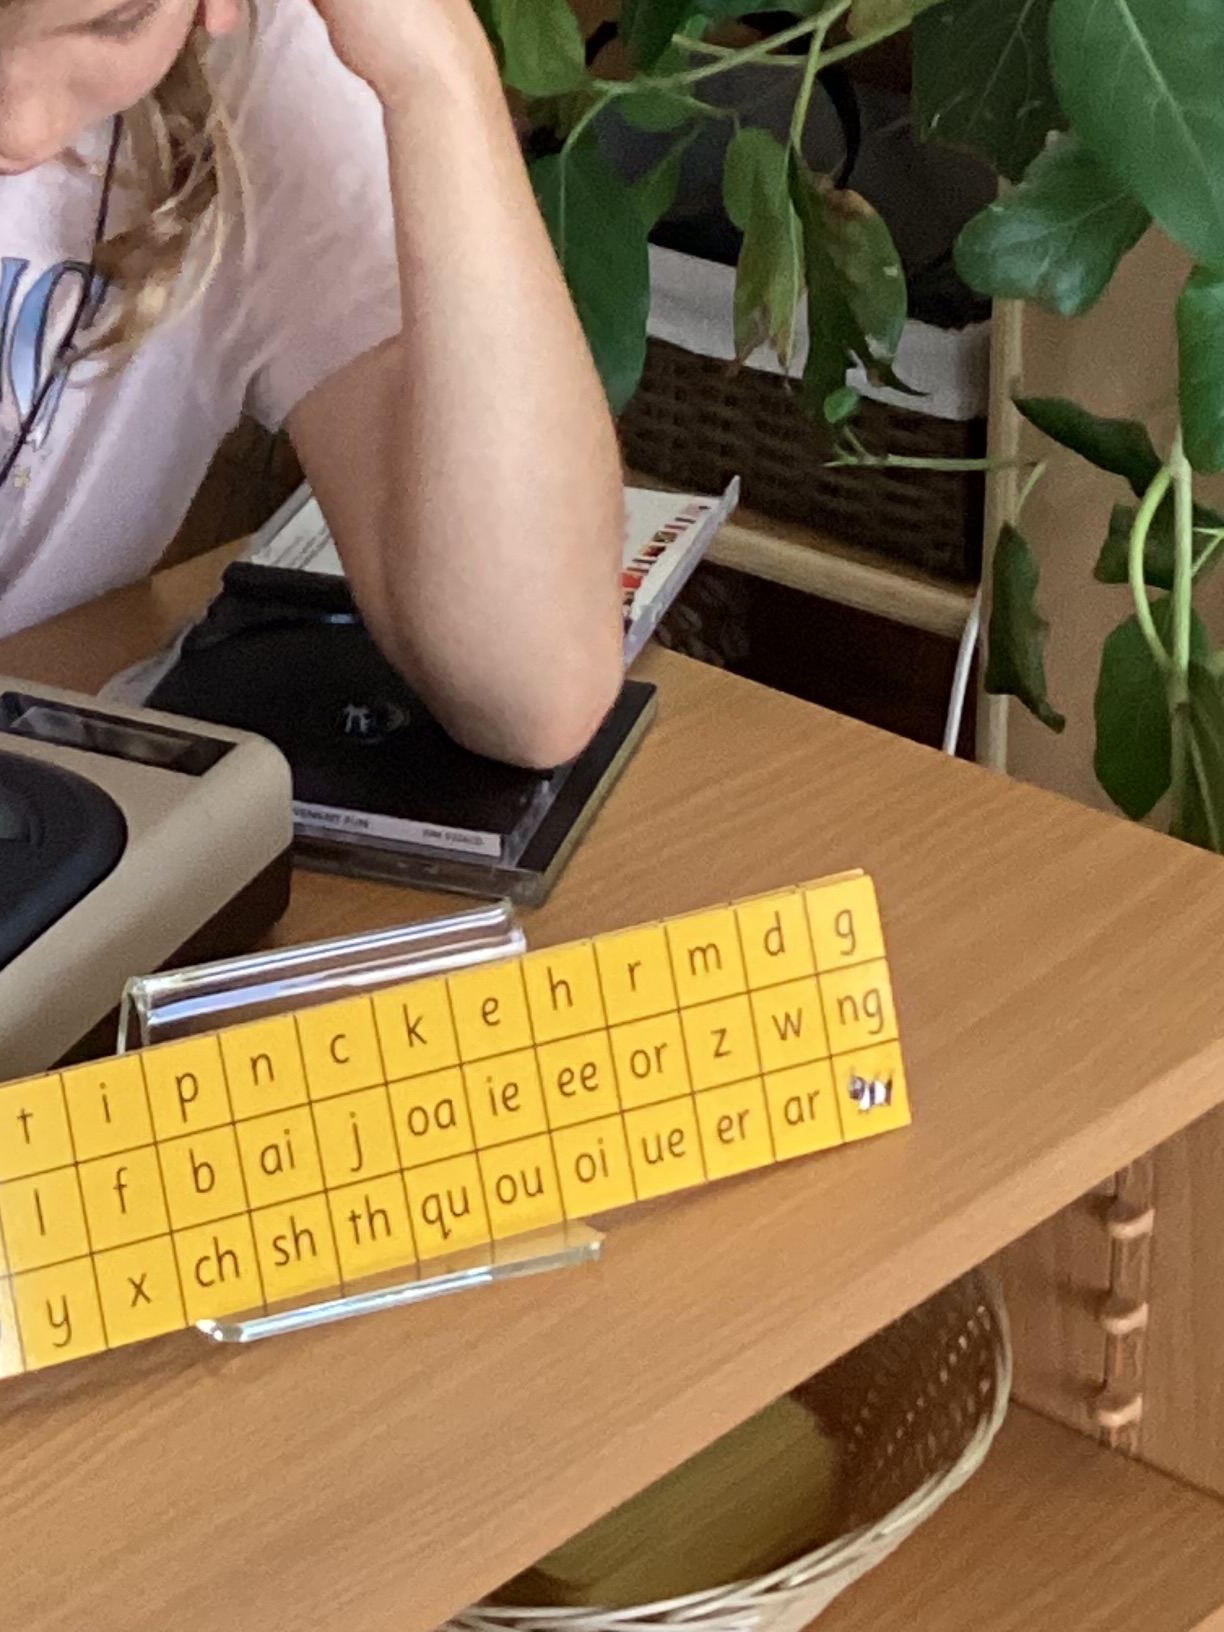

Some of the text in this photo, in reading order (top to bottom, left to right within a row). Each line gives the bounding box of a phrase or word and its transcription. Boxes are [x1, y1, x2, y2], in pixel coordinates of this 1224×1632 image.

[17, 1109, 32, 1144] t
[100, 1083, 111, 1123] i
[175, 1073, 198, 1123] p
[250, 1054, 274, 1085] n
[330, 1034, 349, 1064] c
[403, 1004, 427, 1047] k
[482, 998, 500, 1026] e
[547, 967, 573, 1010] h
[628, 961, 641, 991] r
[688, 943, 722, 975] m
[764, 911, 785, 956] d
[835, 909, 856, 956] g
[114, 1167, 127, 1214] f
[189, 1149, 215, 1193] b
[260, 1129, 295, 1175] ai
[350, 1112, 363, 1172] j
[408, 1099, 456, 1136] oa
[487, 1077, 520, 1116] ie
[557, 1062, 598, 1097] ee
[630, 1043, 667, 1079] or
[711, 1028, 731, 1058] z
[772, 1008, 802, 1041] w
[837, 989, 883, 1035] ng
[46, 1295, 72, 1348] y
[128, 1274, 151, 1307] x
[195, 1237, 240, 1287] ch
[273, 1216, 317, 1266] sh
[349, 1195, 391, 1244] th
[422, 1187, 470, 1240] qu
[496, 1167, 544, 1204] ou
[575, 1138, 608, 1183] oi
[642, 1128, 685, 1165] ue
[717, 1109, 749, 1144] er
[784, 1090, 819, 1126] ar
